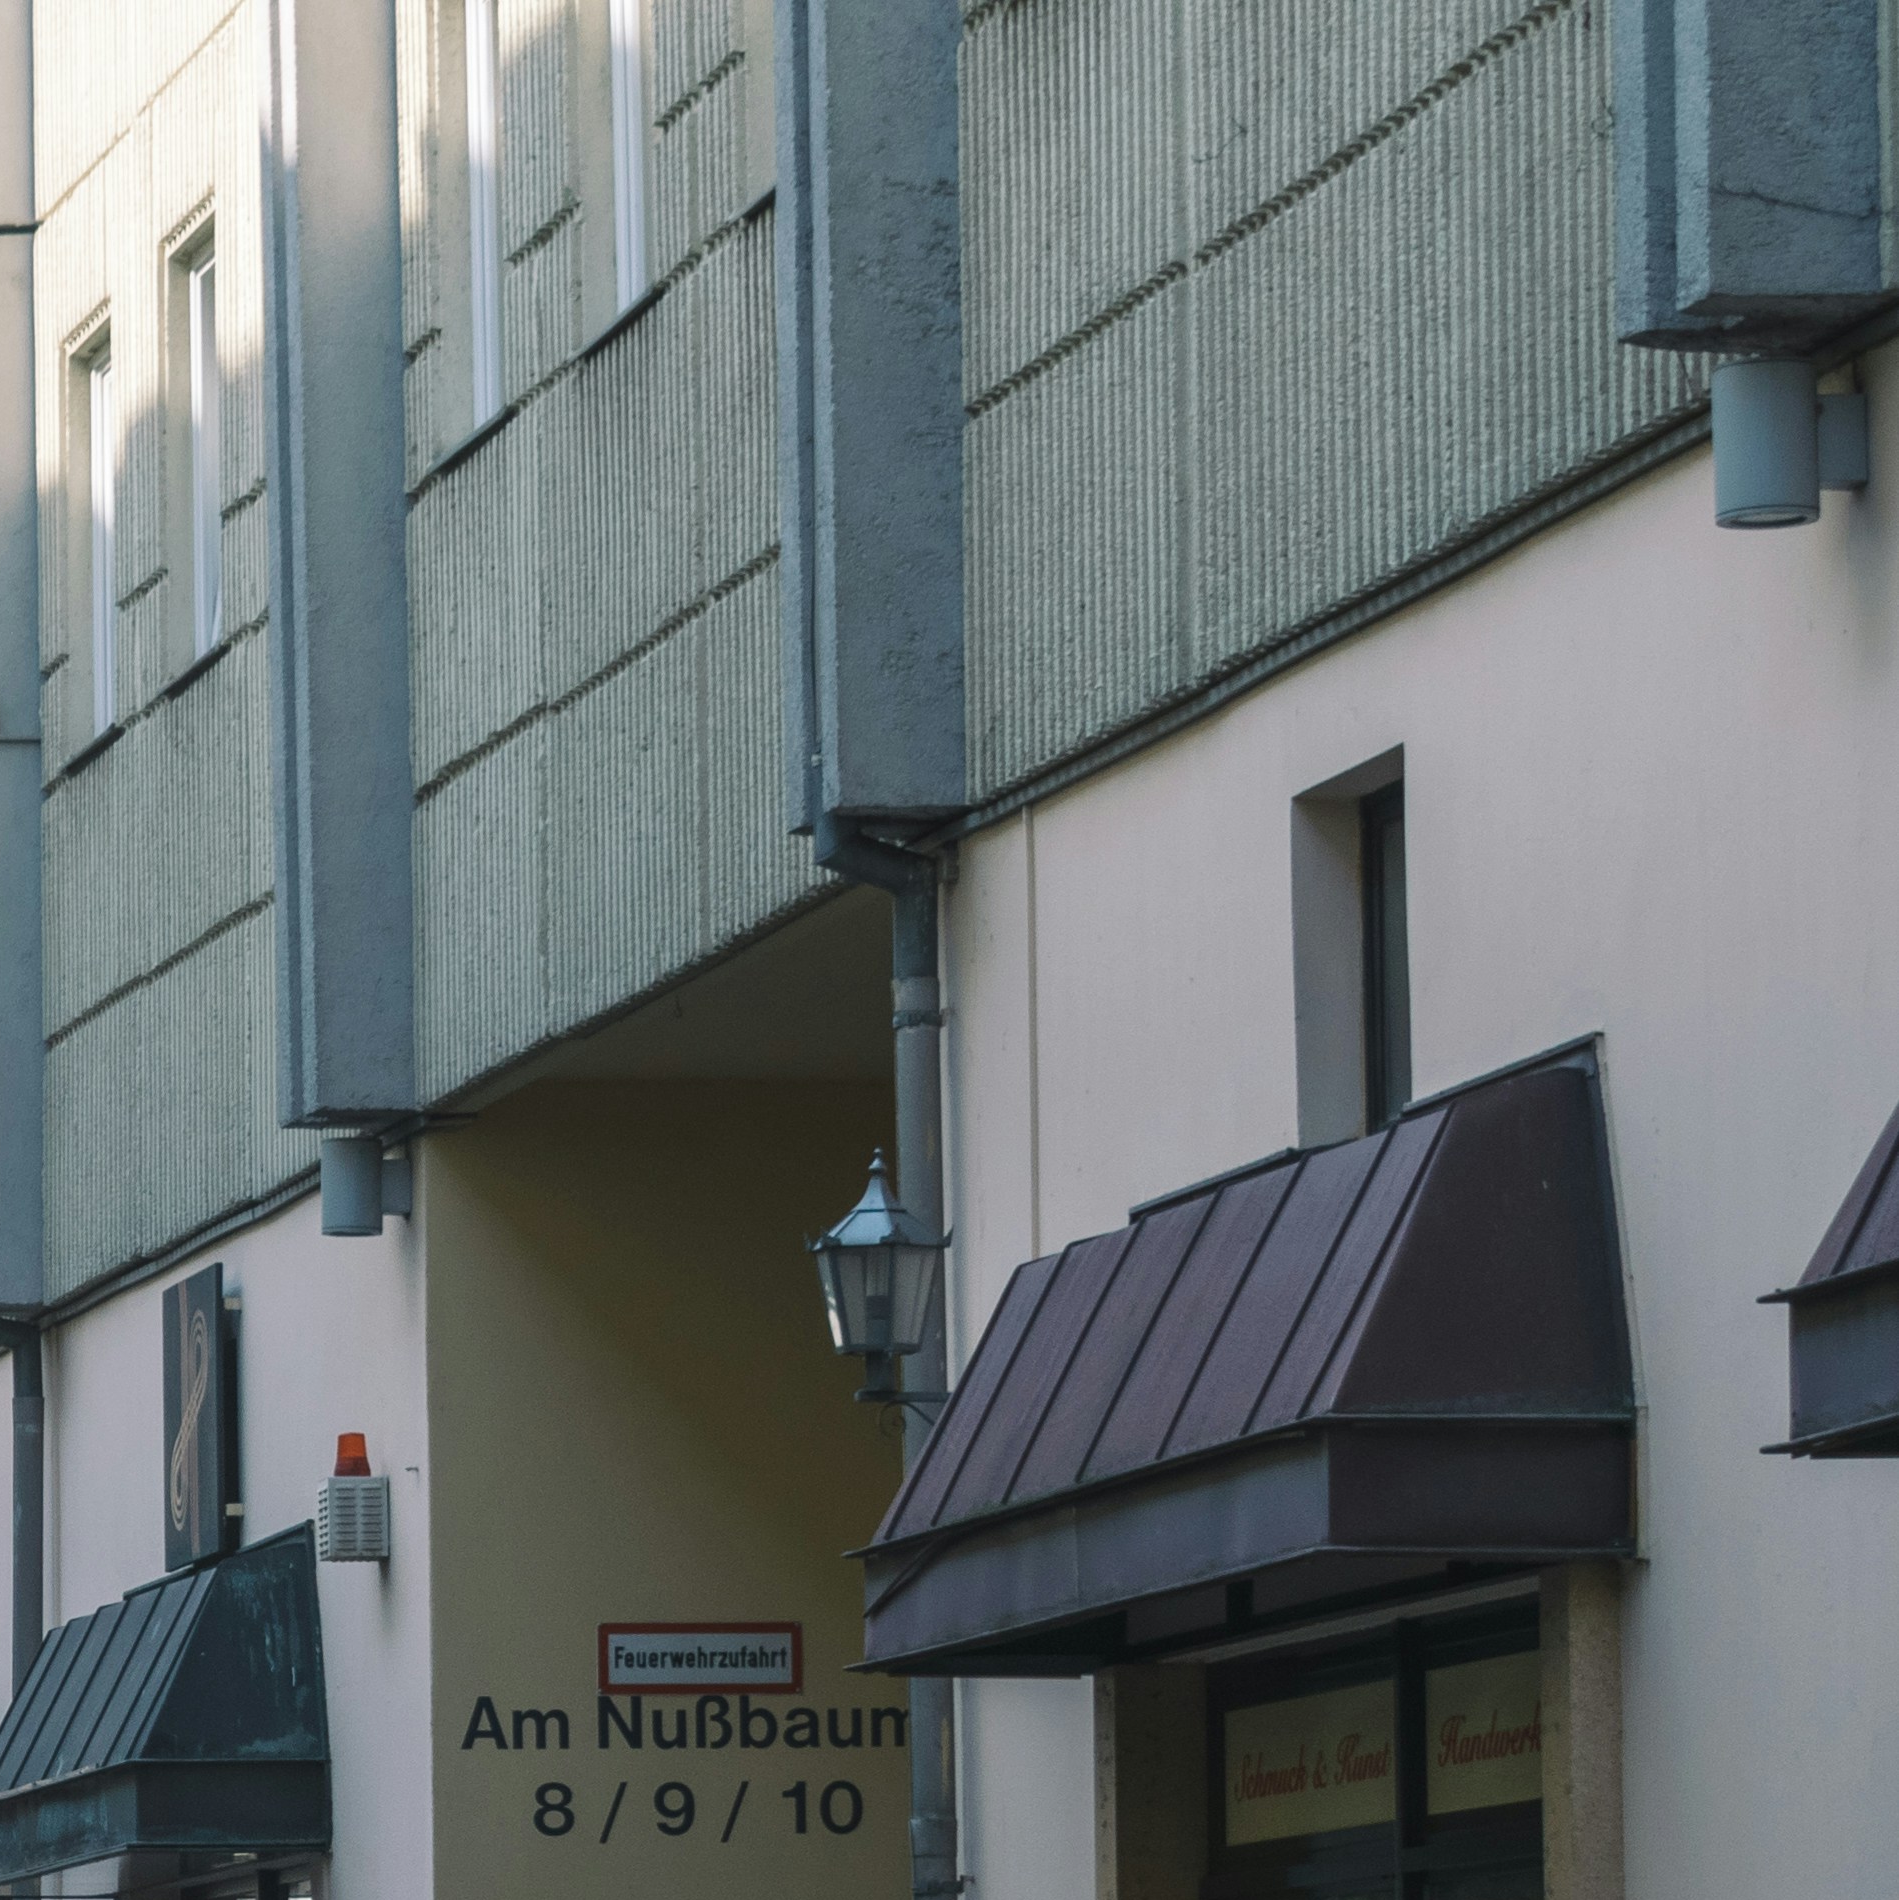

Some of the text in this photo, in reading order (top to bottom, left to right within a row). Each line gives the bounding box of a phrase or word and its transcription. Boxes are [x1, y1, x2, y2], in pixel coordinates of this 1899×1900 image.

[614, 1646, 788, 1669] Feuerwehrzufahrt
[462, 1696, 909, 1749] Am Nußbaum
[1438, 1700, 1542, 1767] Handwerk
[1235, 1733, 1391, 1801] Schmuck & Kunst
[534, 1782, 575, 1835] 8
[654, 1781, 695, 1835] 9
[782, 1780, 863, 1834] 10
